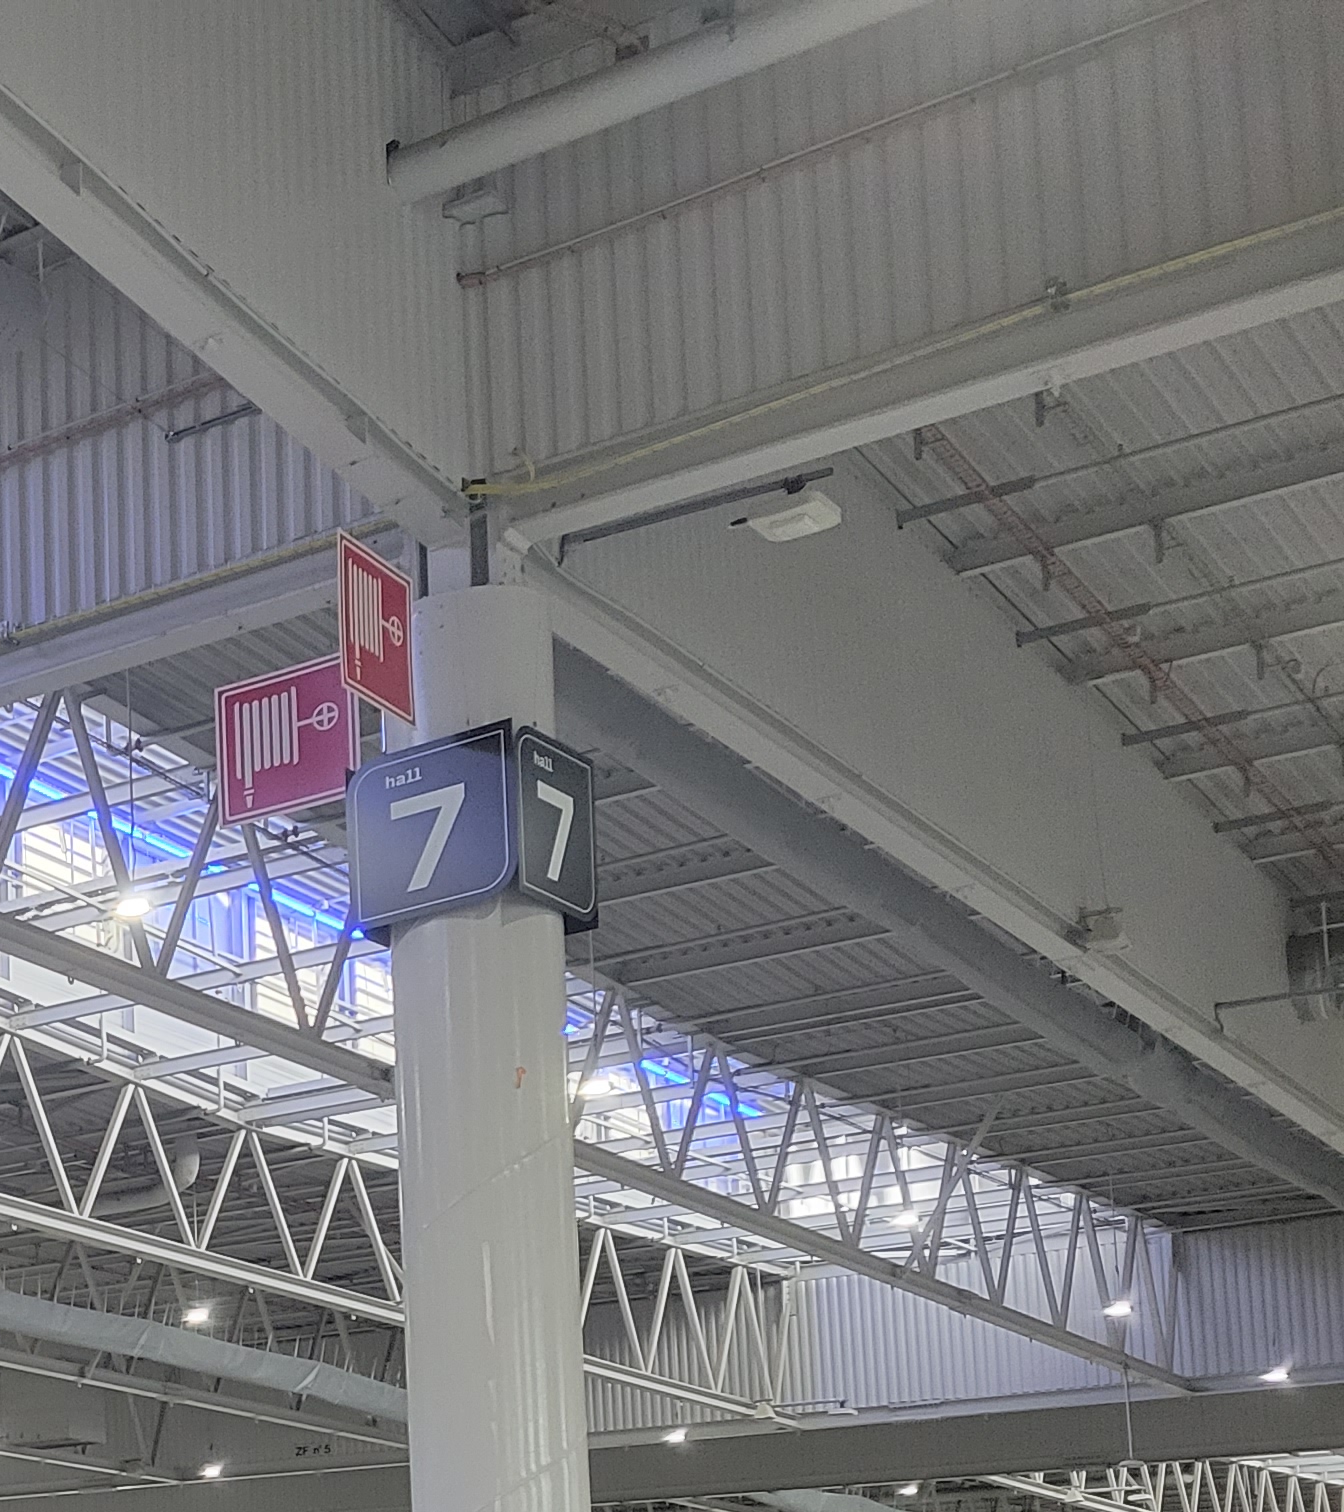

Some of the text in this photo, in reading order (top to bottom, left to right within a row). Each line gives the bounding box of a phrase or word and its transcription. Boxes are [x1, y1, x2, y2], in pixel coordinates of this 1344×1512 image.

[534, 751, 554, 773] hall
[385, 767, 422, 789] hall
[390, 782, 465, 893] 7
[537, 780, 574, 882] 7
[295, 1446, 309, 1457] ZF
